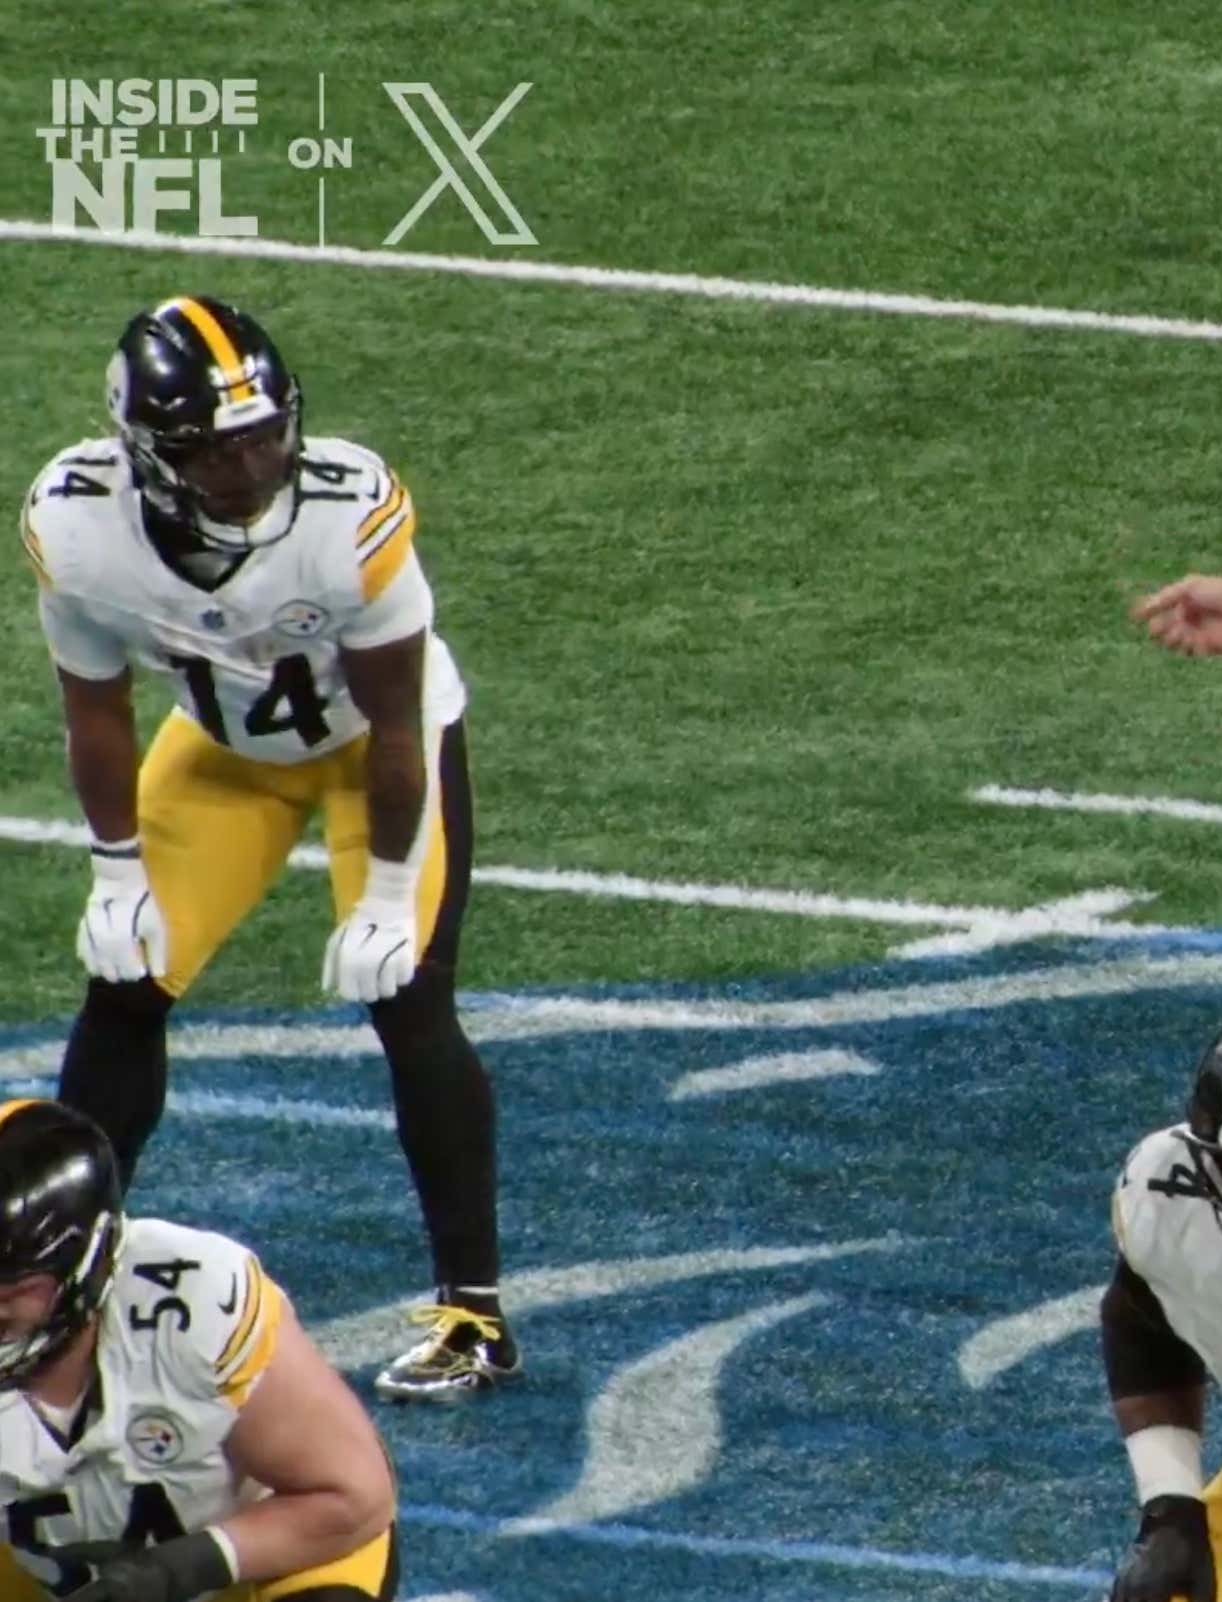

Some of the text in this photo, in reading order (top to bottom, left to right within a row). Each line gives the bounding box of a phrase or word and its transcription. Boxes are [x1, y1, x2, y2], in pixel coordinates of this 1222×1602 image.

[48, 456, 117, 498] 14
[300, 459, 362, 502] 14
[170, 653, 332, 747] 14
[129, 1257, 200, 1332] 54
